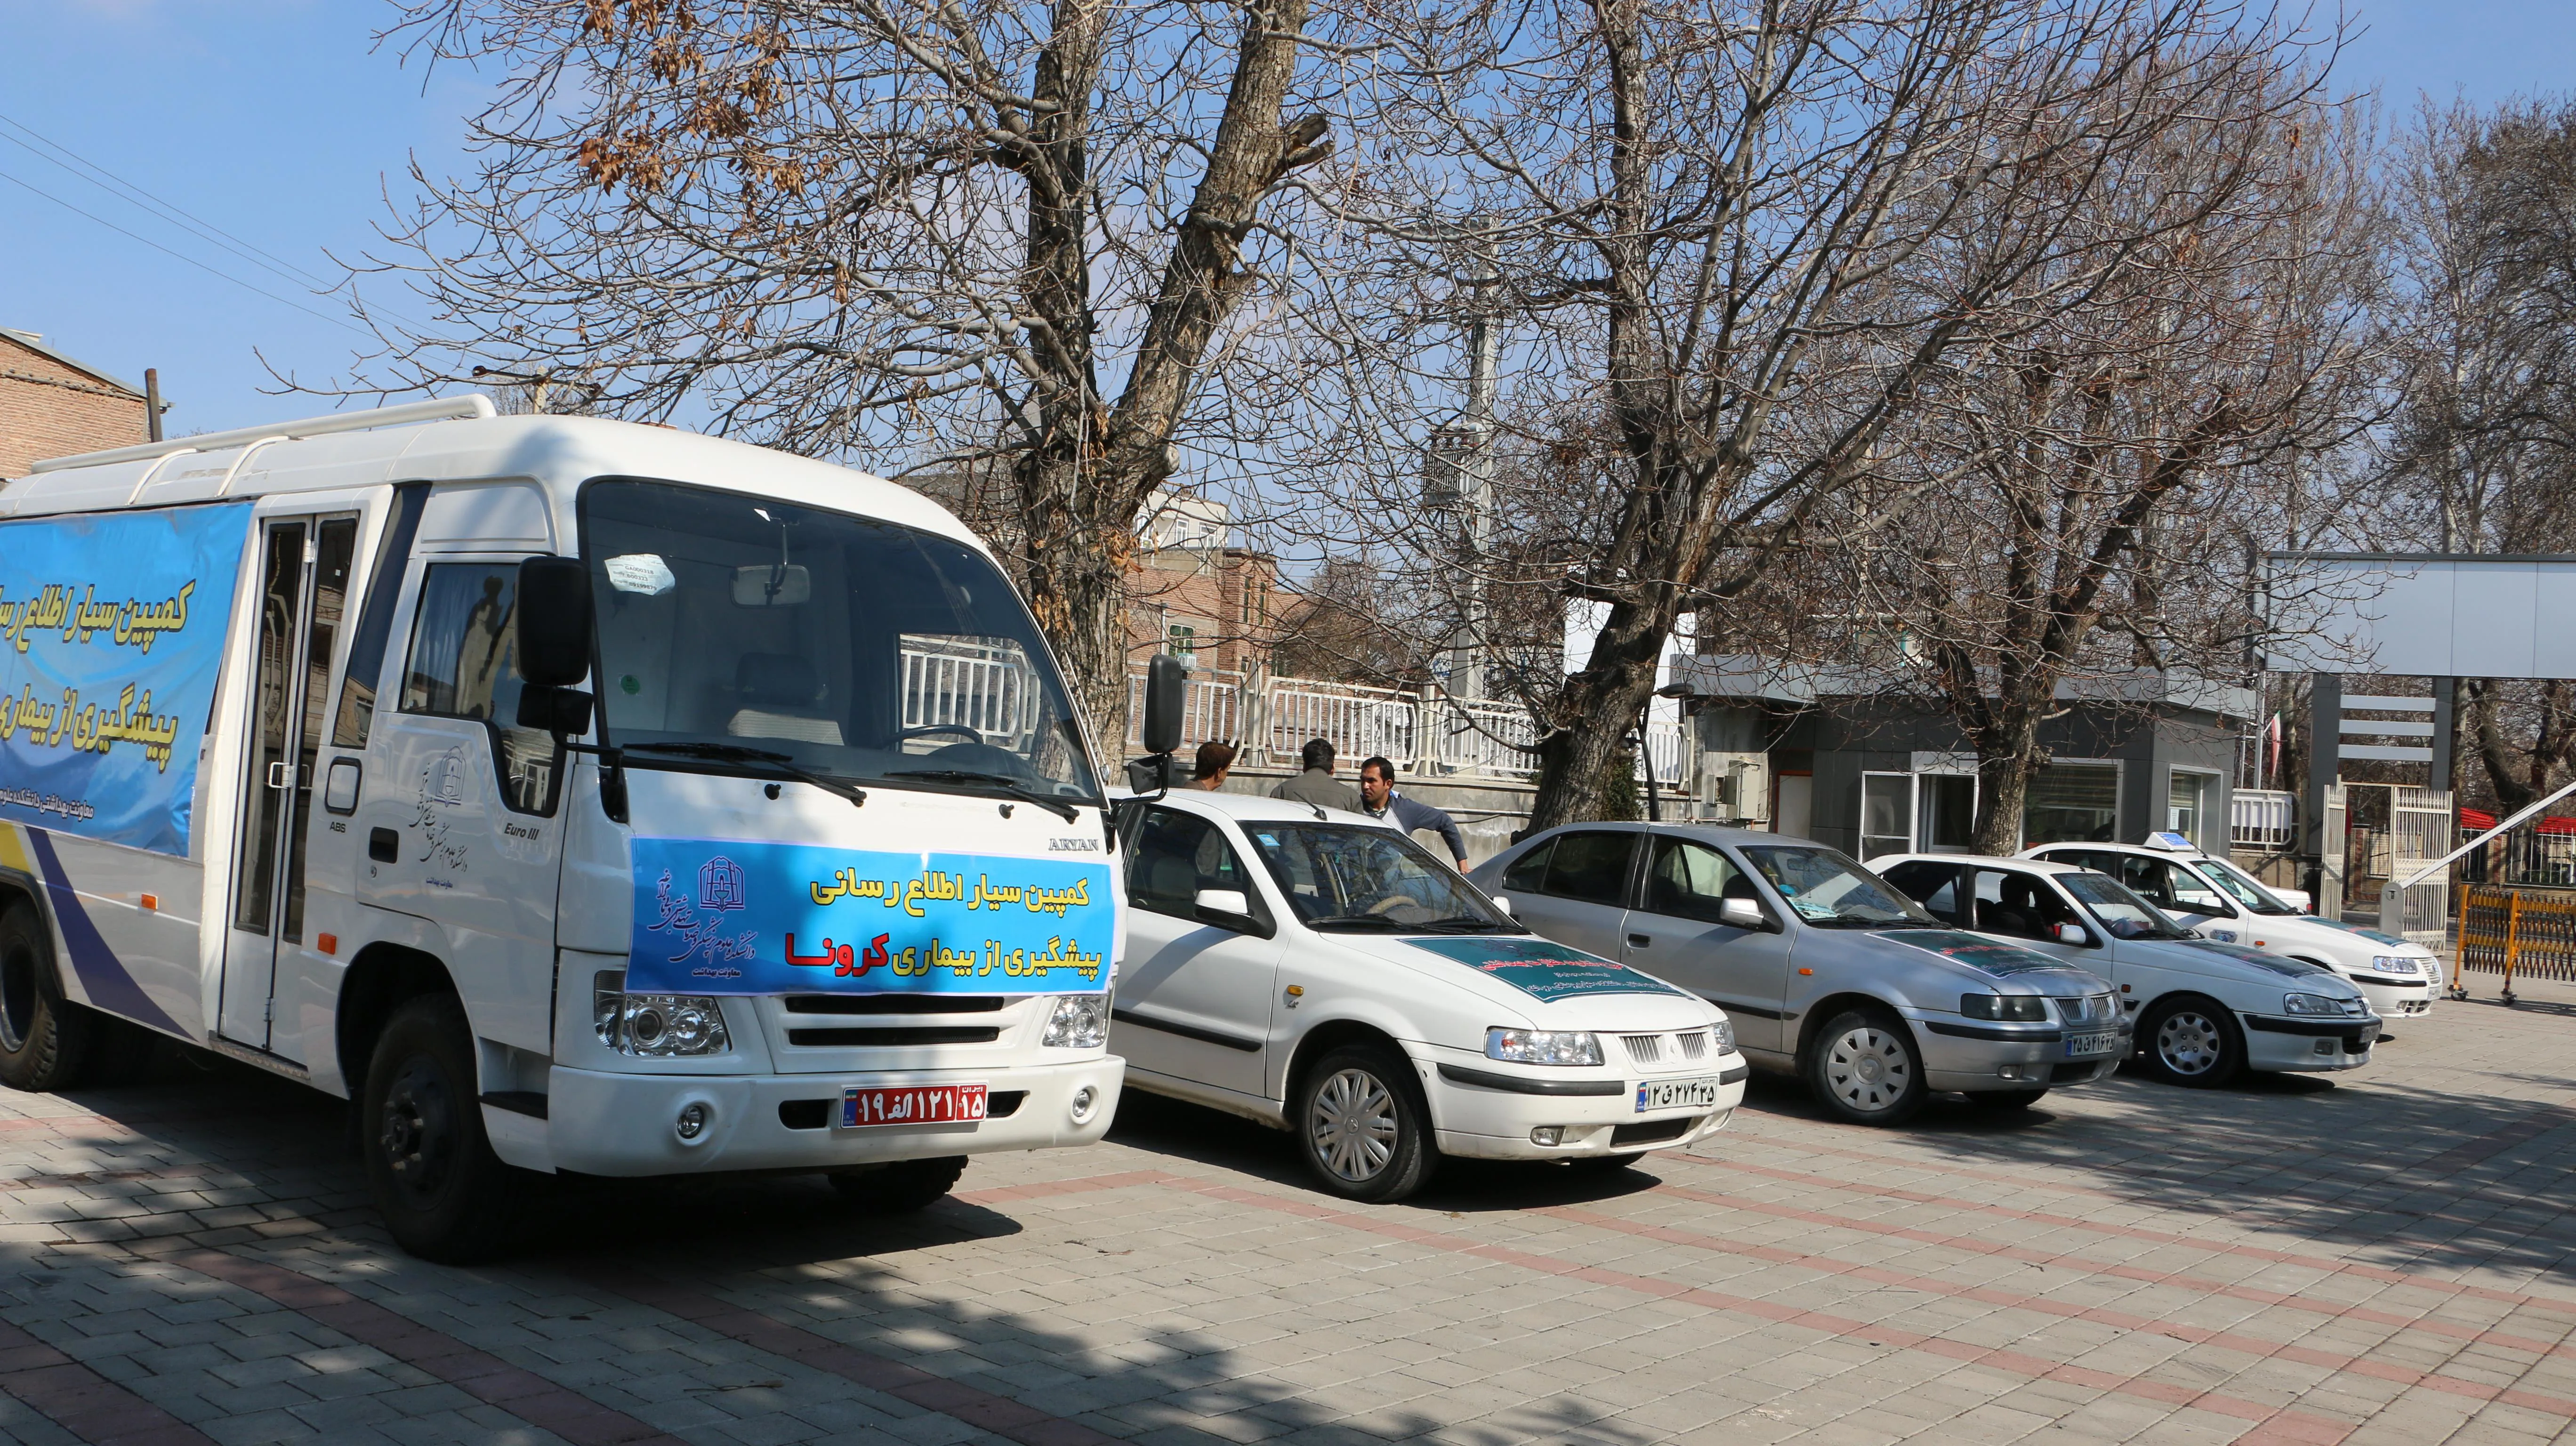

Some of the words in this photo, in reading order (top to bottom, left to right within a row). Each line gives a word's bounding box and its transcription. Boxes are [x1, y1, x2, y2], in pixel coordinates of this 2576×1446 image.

[16, 584, 74, 653] اطلاع
[62, 584, 120, 644] سیار
[114, 578, 196, 655] کمپین
[49, 686, 78, 748] از
[72, 682, 178, 774] پیشگیری
[13, 787, 40, 808] دانشکده
[40, 793, 69, 819] بهداشتی
[69, 800, 94, 822] معاونت
[330, 821, 346, 833] ABS
[504, 823, 526, 838] Euro
[527, 827, 539, 841] III
[1048, 838, 1099, 851] ARYAN
[810, 867, 901, 908] رسانی
[903, 870, 963, 917] اطلاع
[967, 874, 1022, 911] سیار
[1024, 877, 1091, 918] کمپین
[692, 967, 717, 978] بهداشت
[718, 967, 741, 979] معاونت
[785, 932, 890, 977] کرونا
[892, 938, 976, 977] بیماری
[978, 939, 1001, 976] از
[1004, 935, 1102, 982] پیشگیری
